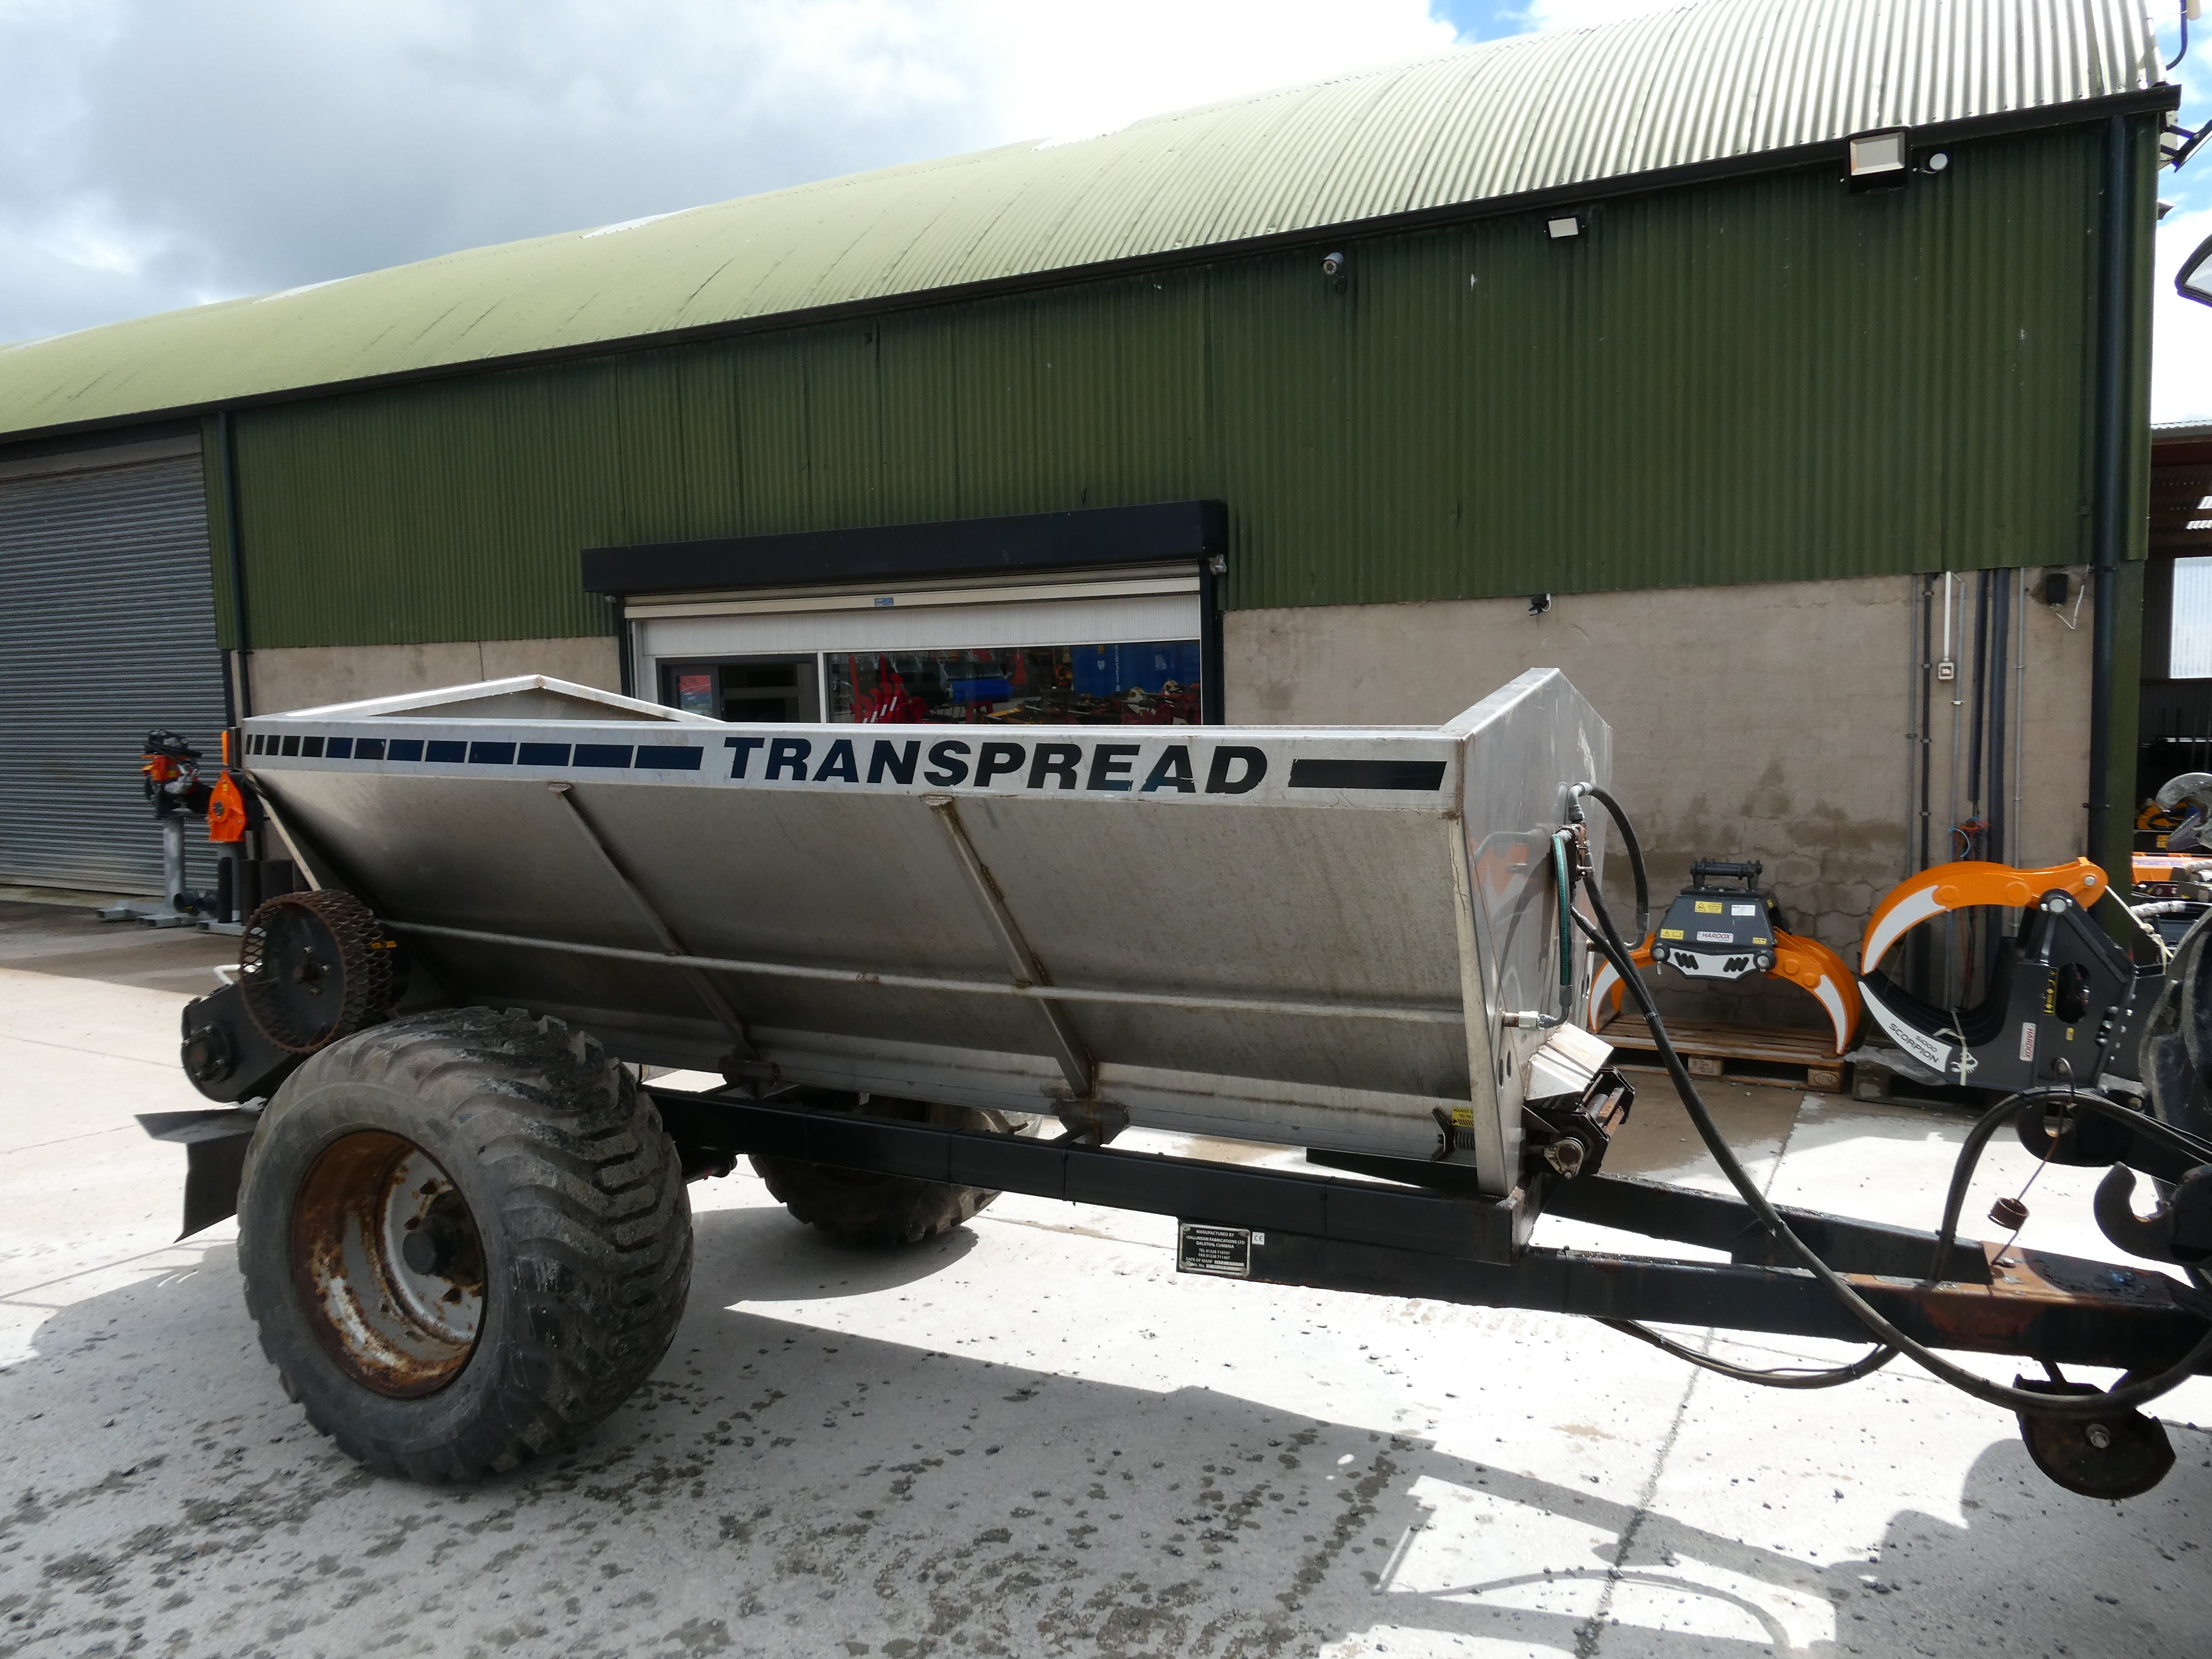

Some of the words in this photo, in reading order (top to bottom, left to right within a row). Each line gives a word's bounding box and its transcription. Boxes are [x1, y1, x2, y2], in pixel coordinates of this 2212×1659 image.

[724, 736, 1268, 795] TRANSPREAD
[1889, 1023, 1939, 1063] SCORPION
[2025, 1027, 2035, 1058] HARDOX
